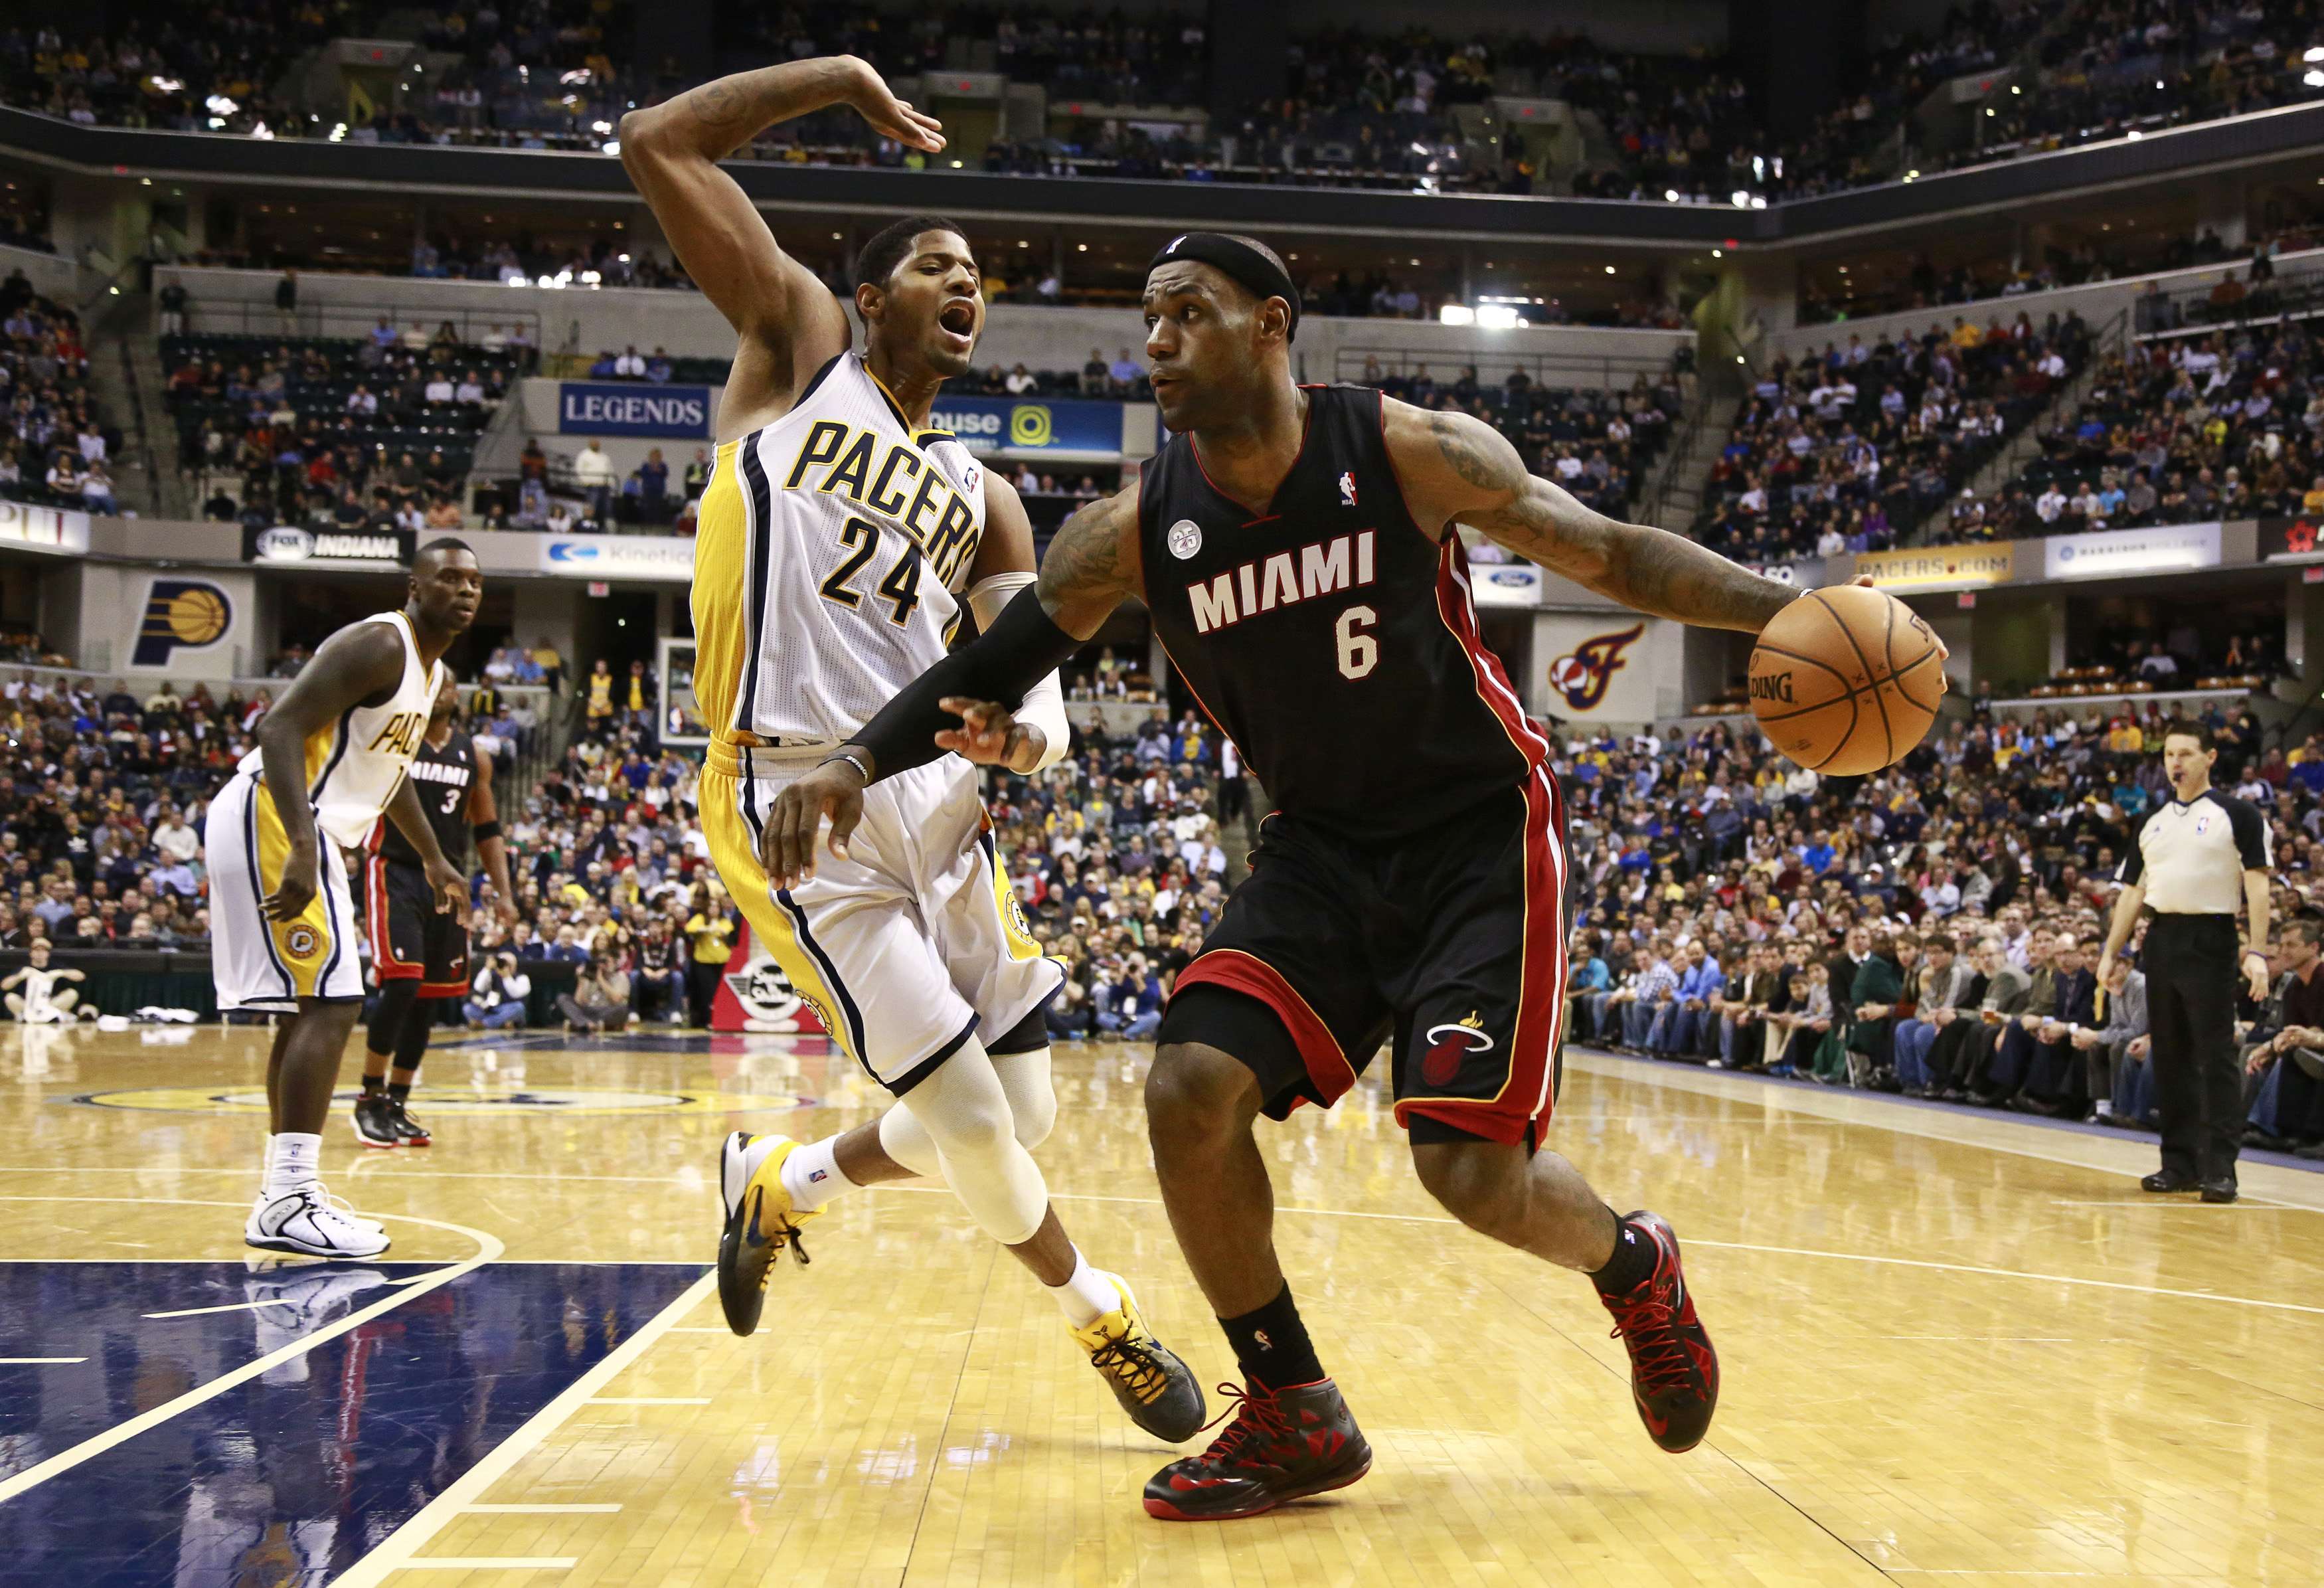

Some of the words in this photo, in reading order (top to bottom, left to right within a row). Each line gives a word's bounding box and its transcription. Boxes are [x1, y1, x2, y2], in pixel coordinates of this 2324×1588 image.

[566, 394, 704, 426] LEGENDS
[929, 412, 1001, 434] ouse
[314, 533, 398, 559] INDIANA
[610, 542, 693, 565] Kinetic
[820, 516, 922, 629] 24
[1186, 528, 1376, 636] MIAMI
[1335, 603, 1380, 682] 6
[1751, 671, 1793, 703] DING
[408, 760, 470, 787] MIAMI
[440, 788, 461, 814] 3
